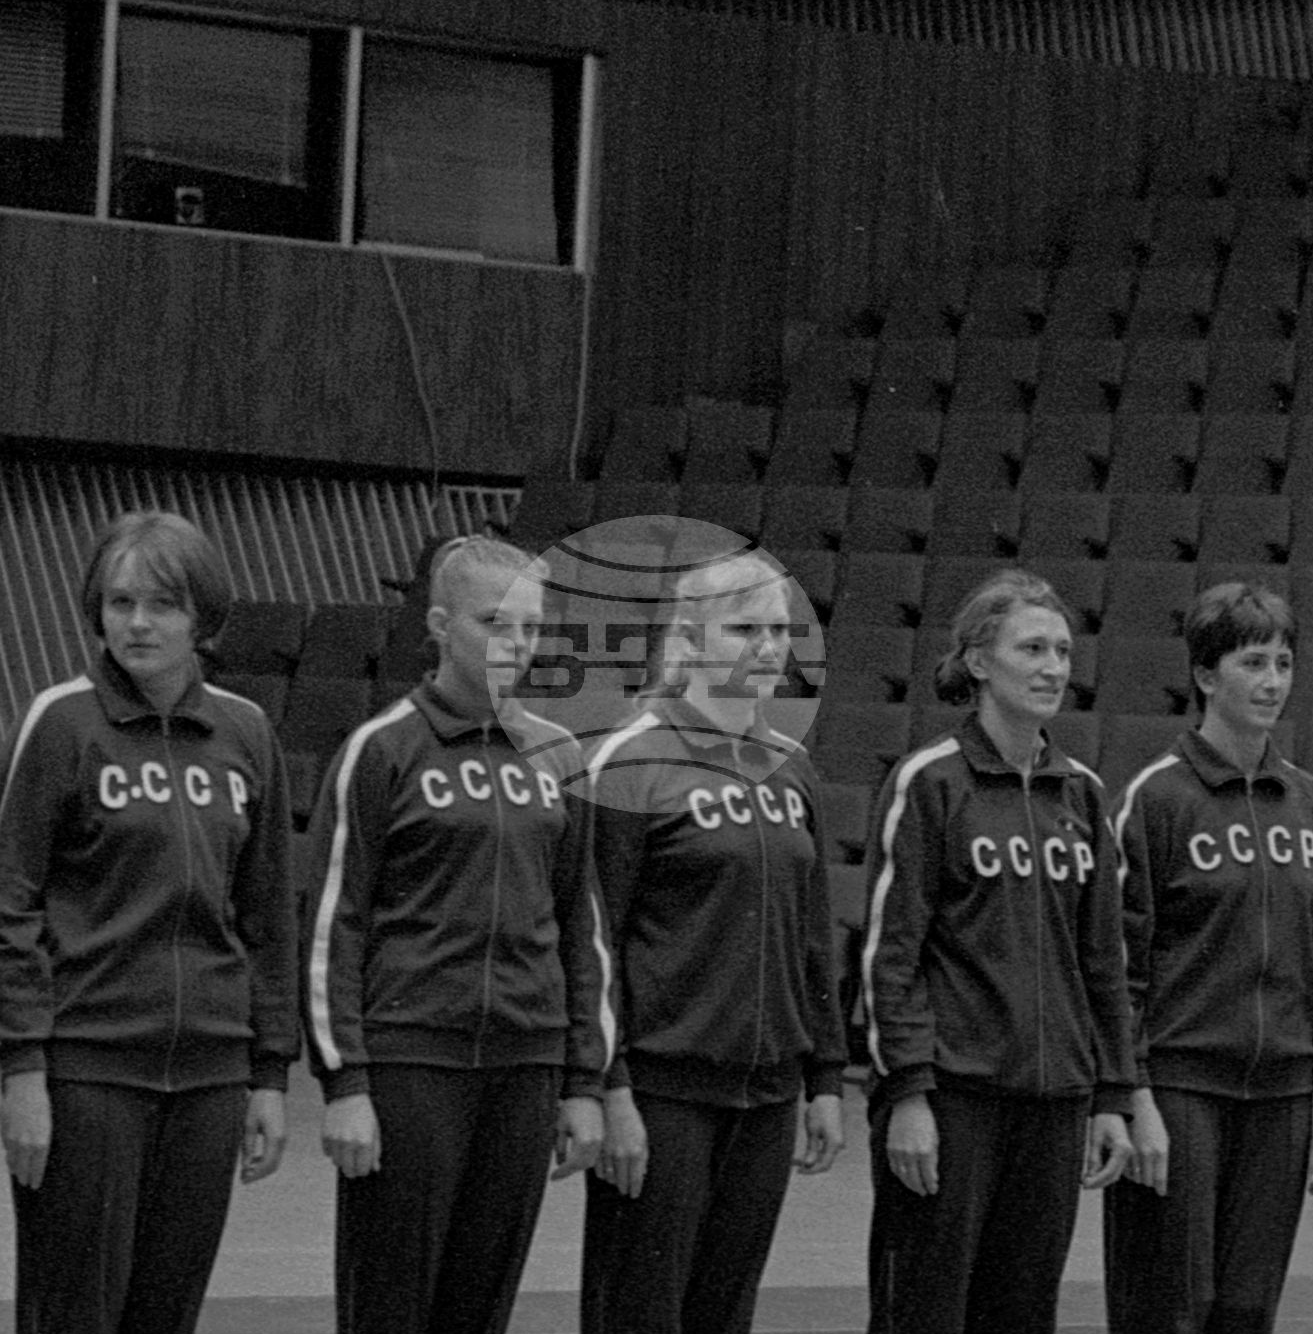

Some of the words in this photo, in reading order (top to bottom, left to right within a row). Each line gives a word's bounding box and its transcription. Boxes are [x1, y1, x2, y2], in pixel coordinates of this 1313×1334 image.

[420, 760, 561, 809] СССР
[689, 784, 805, 829] СССР
[971, 835, 1094, 884] СССР
